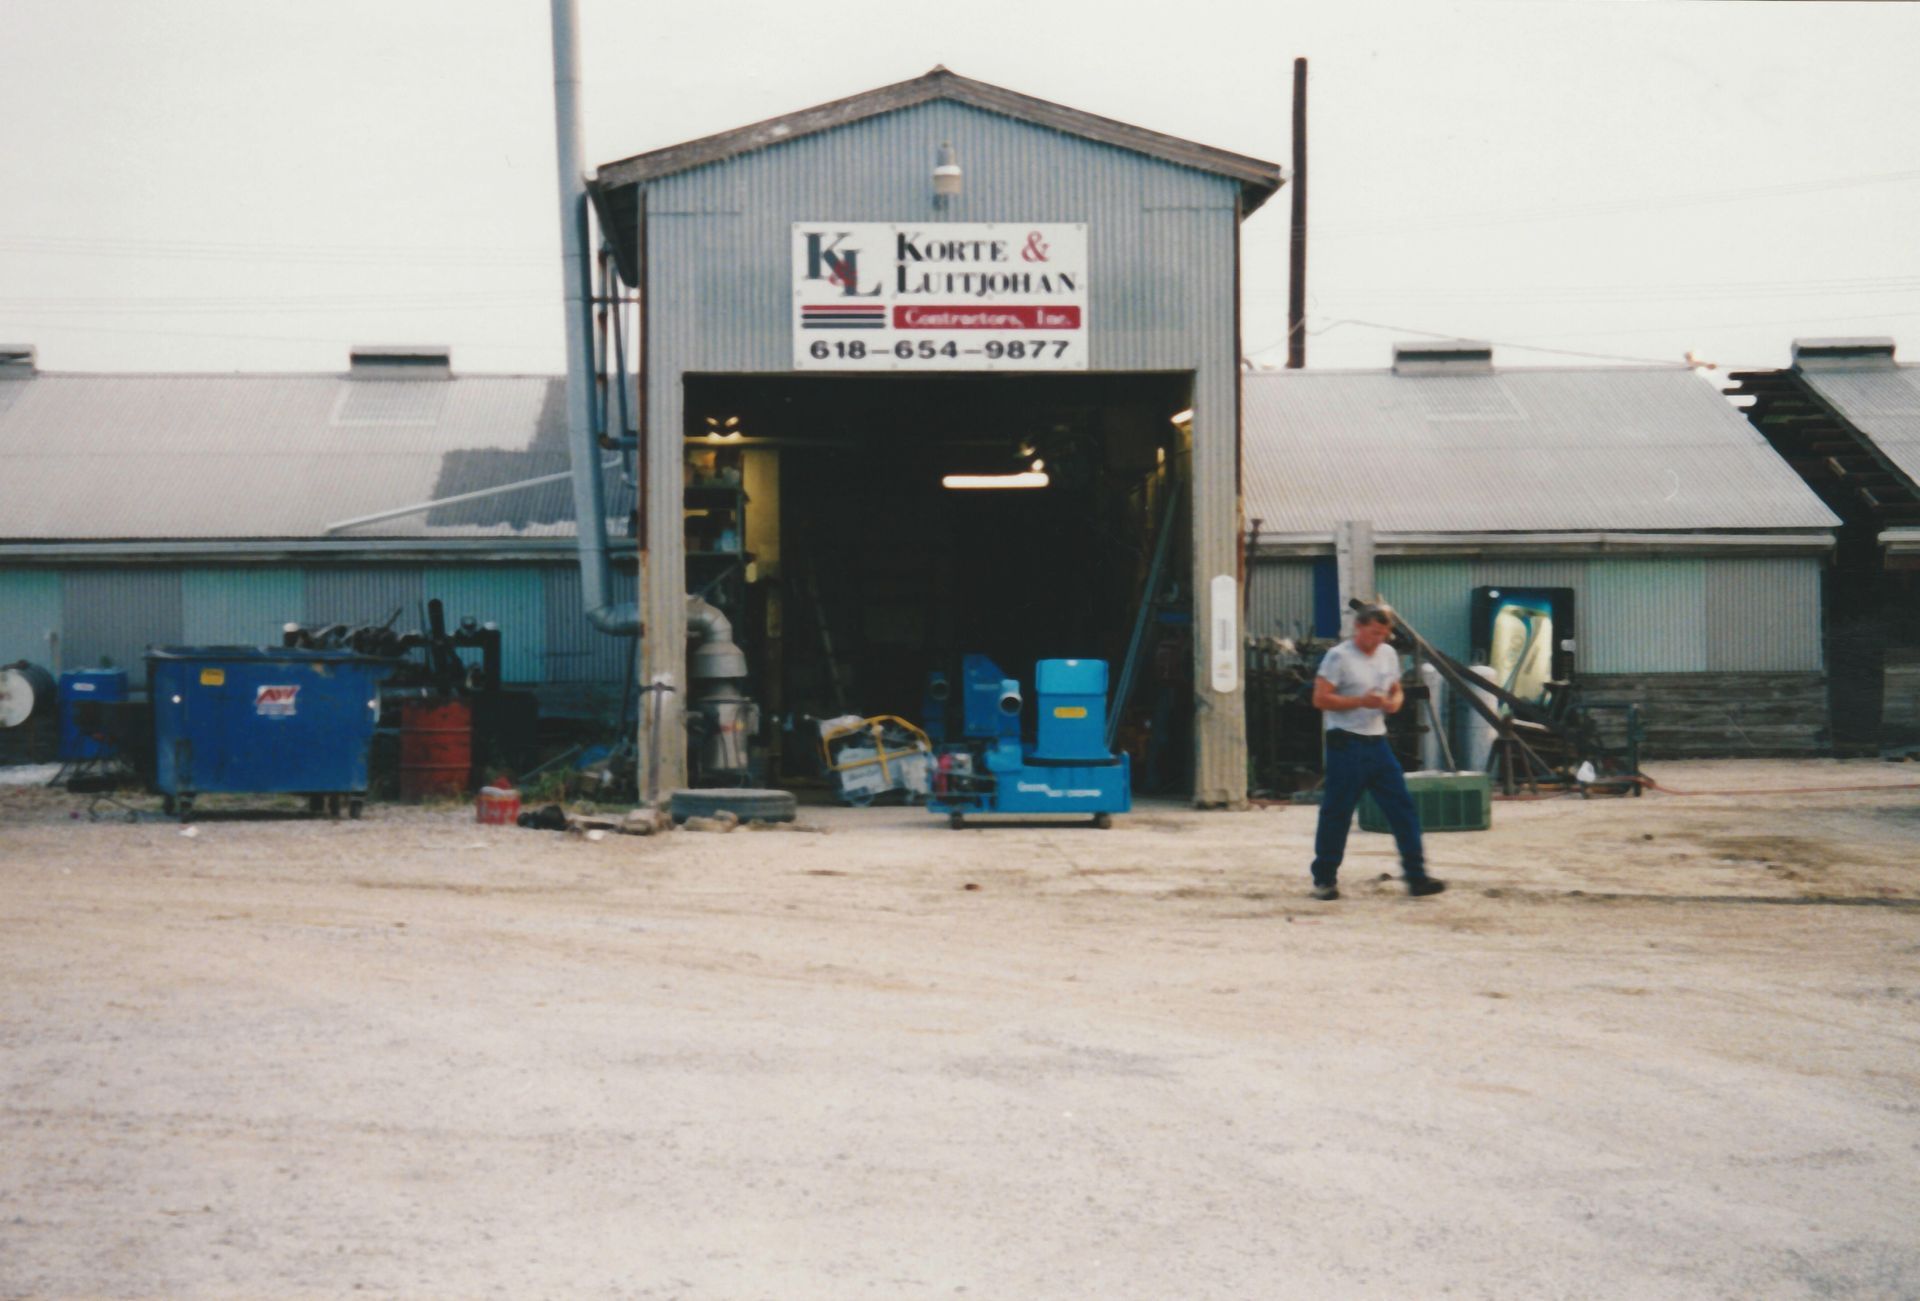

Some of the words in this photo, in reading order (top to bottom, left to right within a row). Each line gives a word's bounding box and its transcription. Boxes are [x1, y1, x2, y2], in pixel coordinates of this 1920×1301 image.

[896, 231, 1008, 262] KORTE
[1021, 231, 1050, 263] &
[896, 264, 1076, 297] LUITJOHAN
[1036, 308, 1073, 326] Inc.
[809, 340, 1070, 359] 618-654-9877
